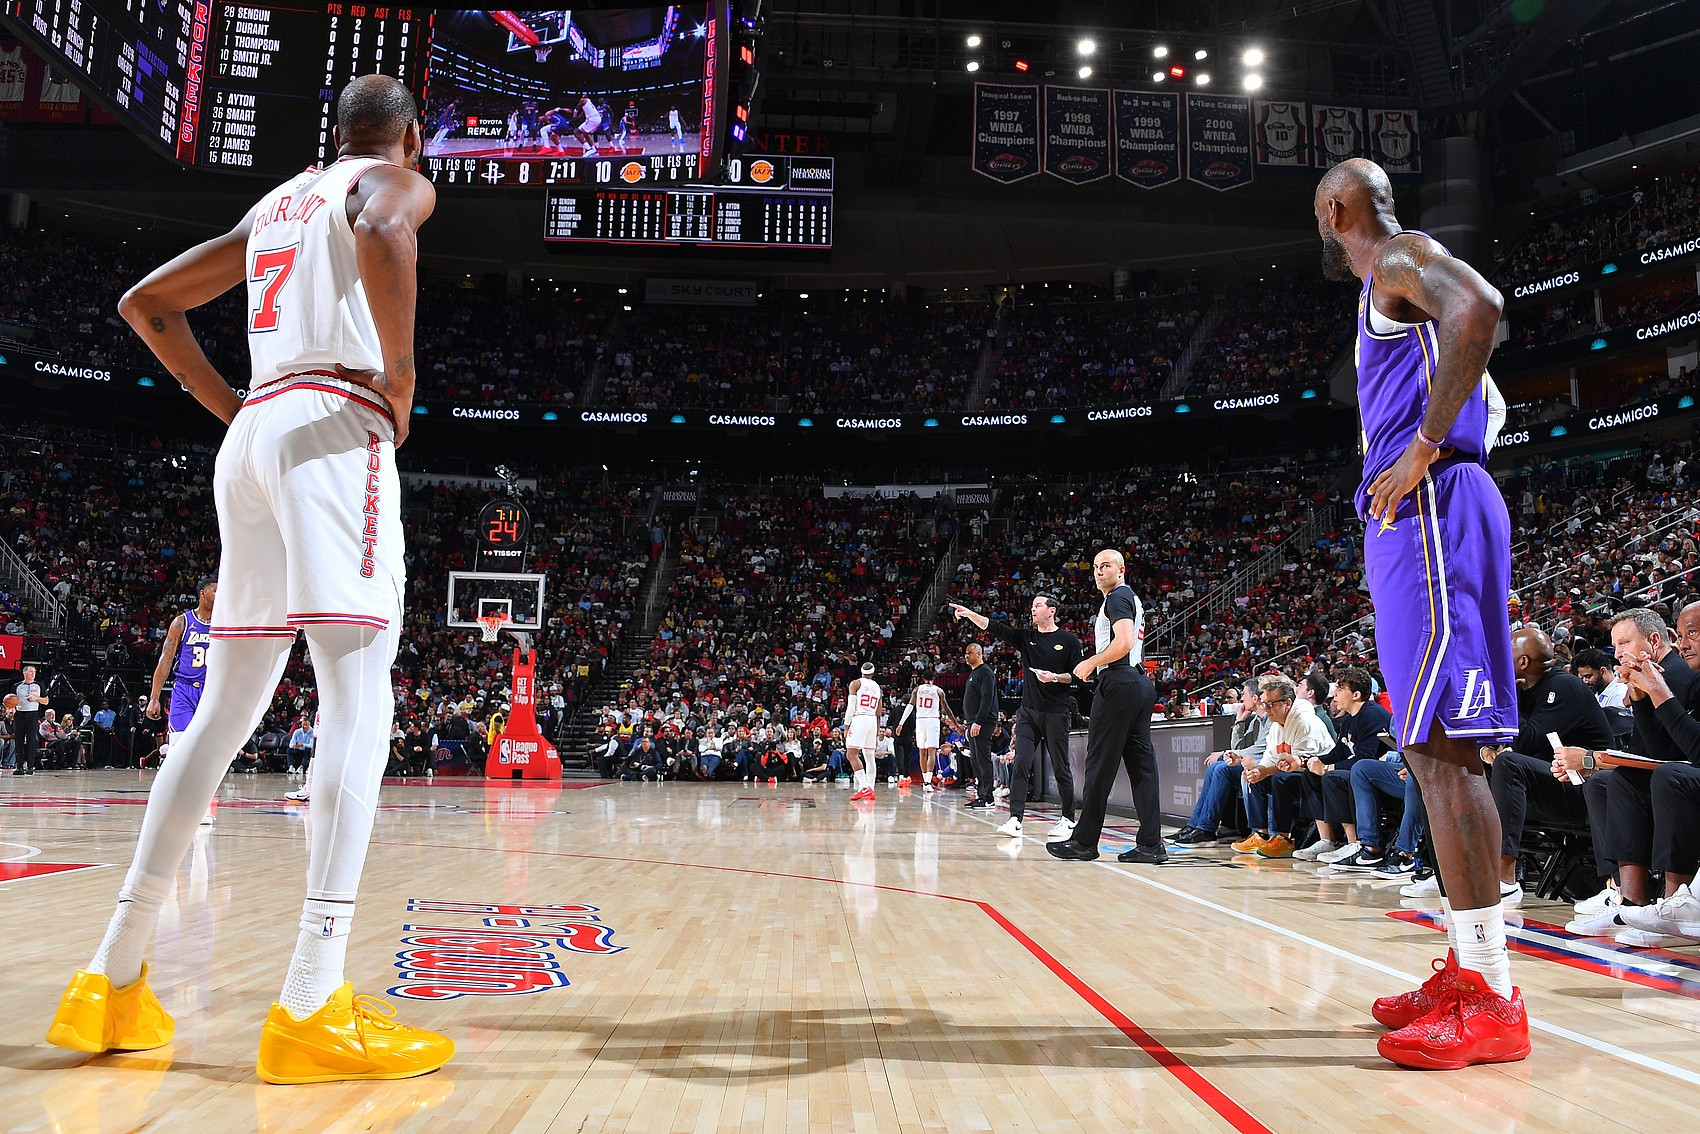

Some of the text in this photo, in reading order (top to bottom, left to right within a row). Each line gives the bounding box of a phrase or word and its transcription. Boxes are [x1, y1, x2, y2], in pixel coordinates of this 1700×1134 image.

[327, 4, 412, 20] PTS REB AST FLS
[53, 14, 59, 28] 0
[92, 16, 97, 30] 2
[224, 6, 409, 34] 28 SENGUN 2 2 1 0
[33, 13, 62, 48] POSS 9.3
[90, 31, 94, 43] 1
[225, 20, 407, 48] 7 DURANT 0 0 0 0
[89, 46, 94, 60] 0
[224, 35, 405, 61] 1 THOMPSON 4 3 0 1
[220, 49, 405, 76] 10 SMITH JR. 0 1 1 2
[180, 1, 208, 142] ROCKETS
[219, 63, 332, 85] 17 EASON 2
[319, 89, 334, 101] PTS
[1010, 92, 1032, 100] Season
[1057, 94, 1098, 103] Back-to-Back
[216, 92, 329, 114] 5 AYTON 4
[1133, 99, 1139, 107] 3
[1162, 100, 1171, 108] 10
[1217, 100, 1248, 110] Champs
[212, 107, 327, 129] 36 SMART 0
[993, 110, 1020, 121] 1997
[1064, 112, 1091, 124] 1998
[1133, 117, 1162, 128] 1999
[990, 122, 1023, 134] WNBA
[1060, 124, 1095, 136] WNBA
[1205, 119, 1233, 130] 2000
[212, 121, 326, 144] 77 DONCIC 0
[467, 127, 502, 137] REPLAY
[1130, 128, 1165, 139] WNBA
[1202, 131, 1236, 143] WNBA
[1275, 131, 1289, 141] 10
[755, 133, 832, 154] NTER
[979, 132, 1035, 147] Champions
[1050, 135, 1107, 149] Champions
[1119, 139, 1176, 152] Champions
[209, 136, 325, 158] 23 JAMES 6
[1192, 142, 1249, 155] Champions
[209, 150, 253, 166] 15 REAVES
[651, 154, 697, 169] TOL FLS CC
[429, 159, 475, 172] TOL FLS CC
[550, 161, 576, 179] 7:11
[596, 161, 612, 183] 10
[432, 171, 472, 183] 7 3 1
[519, 162, 530, 184] 8
[654, 166, 693, 181] 7 0 1
[254, 194, 327, 237] DURANT
[1641, 237, 1700, 265] CASAMIGO
[249, 241, 300, 334] 7
[672, 285, 755, 297] SKY COURT
[1515, 271, 1580, 298] CASAMIGOS
[150, 317, 165, 333] 8
[35, 361, 111, 381] CASAMIGOS
[1213, 393, 1280, 411] CASAMIGOS
[452, 408, 520, 420] CASAMIGOS
[581, 411, 648, 424] CASAMIGOS
[709, 414, 776, 426] CASAMIGOS
[1087, 406, 1153, 421] CASAMIGOS
[1589, 404, 1659, 431] CASAMIGOS
[836, 417, 902, 428] CASAMIGOS
[961, 415, 1027, 427] CASAMIGOS
[361, 430, 381, 578] ROCKETS
[496, 509, 520, 521] 7:11
[490, 521, 517, 542] 24
[193, 646, 206, 668] 3
[517, 677, 528, 686] GET
[517, 686, 528, 695] THE
[1449, 667, 1495, 720] LA
[860, 694, 878, 709] 20
[919, 698, 933, 708] 10
[512, 741, 538, 753] League
[512, 752, 530, 764] Pass
